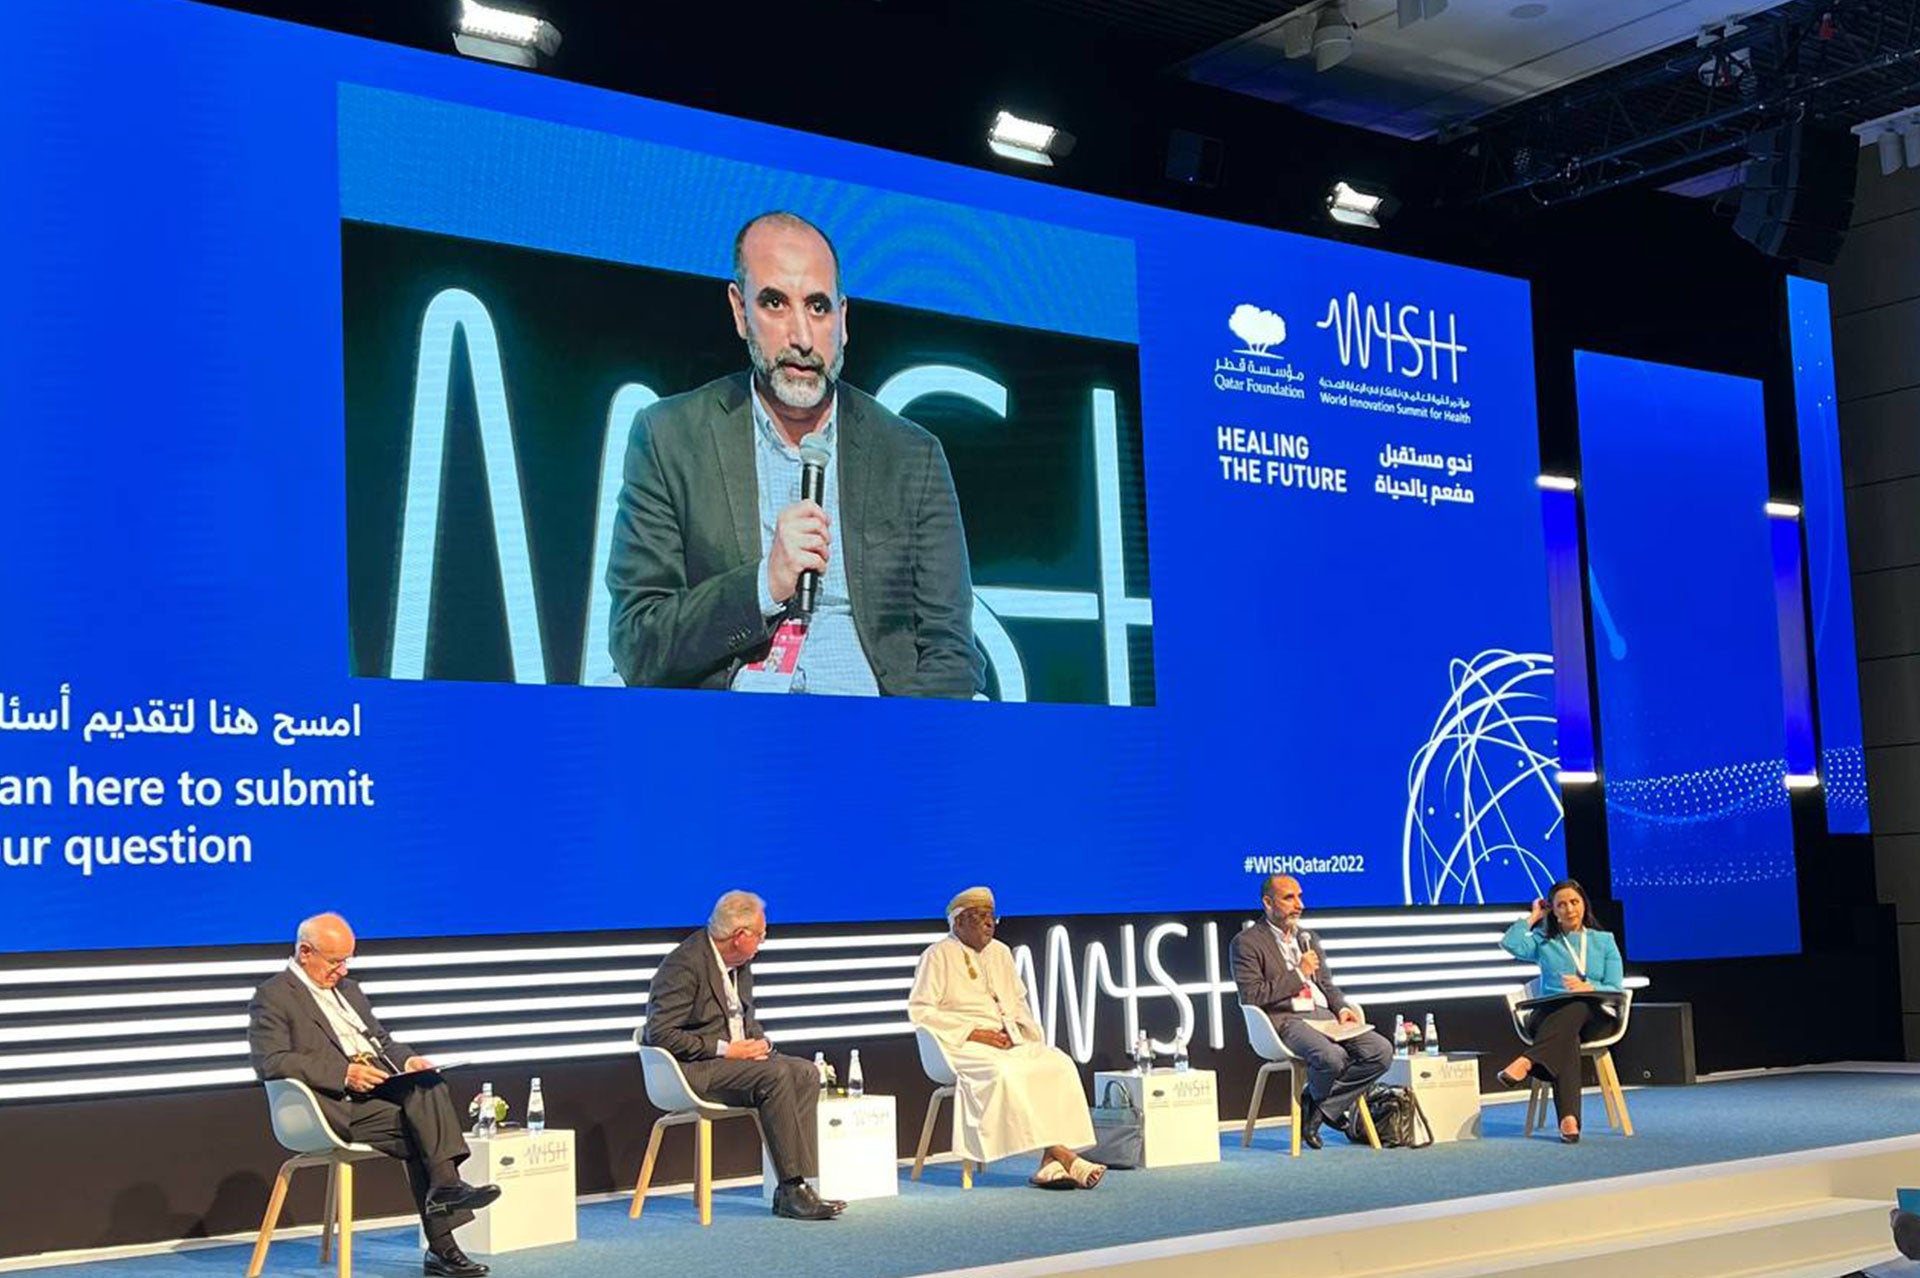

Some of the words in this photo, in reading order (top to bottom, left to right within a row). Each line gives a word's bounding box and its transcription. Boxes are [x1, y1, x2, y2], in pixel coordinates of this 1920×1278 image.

[1316, 291, 1468, 384] WISH
[1214, 357, 1246, 373] قطر
[1214, 373, 1244, 391] Qatar
[1246, 377, 1305, 400] Foundation
[1319, 391, 1347, 406] World
[1349, 396, 1395, 414] Innovation
[1396, 402, 1428, 418] Summit
[1430, 406, 1442, 420] for
[1444, 410, 1472, 424] Health
[1217, 426, 1310, 460] HEALING
[1379, 443, 1444, 469] مستقبل
[1219, 455, 1262, 484] THE
[1266, 460, 1348, 493] FUTURE
[1446, 453, 1473, 476] نحو
[1374, 474, 1428, 504] بالحياة
[1431, 482, 1475, 506] مفعم
[83, 697, 196, 741] لتقديم
[209, 698, 259, 735] هنا
[273, 703, 362, 745] امسح
[68, 766, 164, 805] here
[178, 771, 222, 806] to
[235, 769, 375, 806] submit
[64, 825, 252, 876] question
[1243, 854, 1365, 876] #WISHQatar2022
